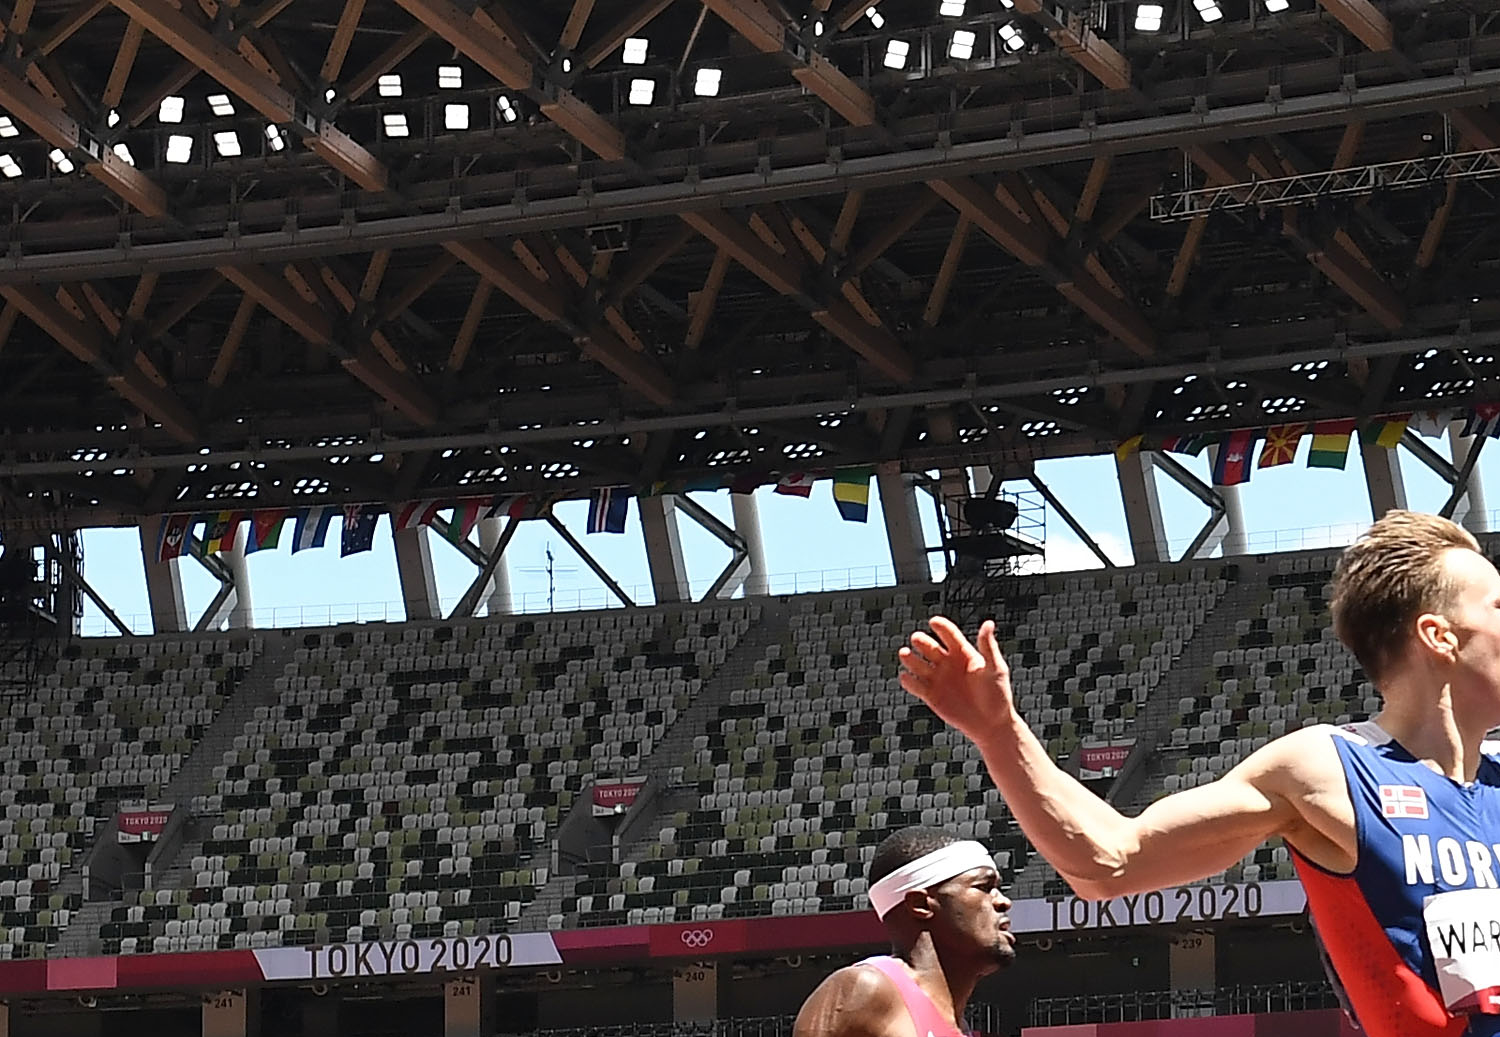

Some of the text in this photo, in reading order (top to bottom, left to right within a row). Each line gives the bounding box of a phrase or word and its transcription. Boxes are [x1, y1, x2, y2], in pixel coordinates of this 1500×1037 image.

[1086, 752, 1110, 761] TOKYO
[599, 789, 622, 798] TOKYO
[125, 817, 149, 825] TOKYO
[1046, 882, 1262, 931] TOKYO 2020
[1182, 938, 1203, 949] 239
[304, 934, 512, 978] TOKYO 2020
[685, 971, 705, 982] 240
[452, 986, 472, 996] 241
[214, 998, 233, 1008] 241
